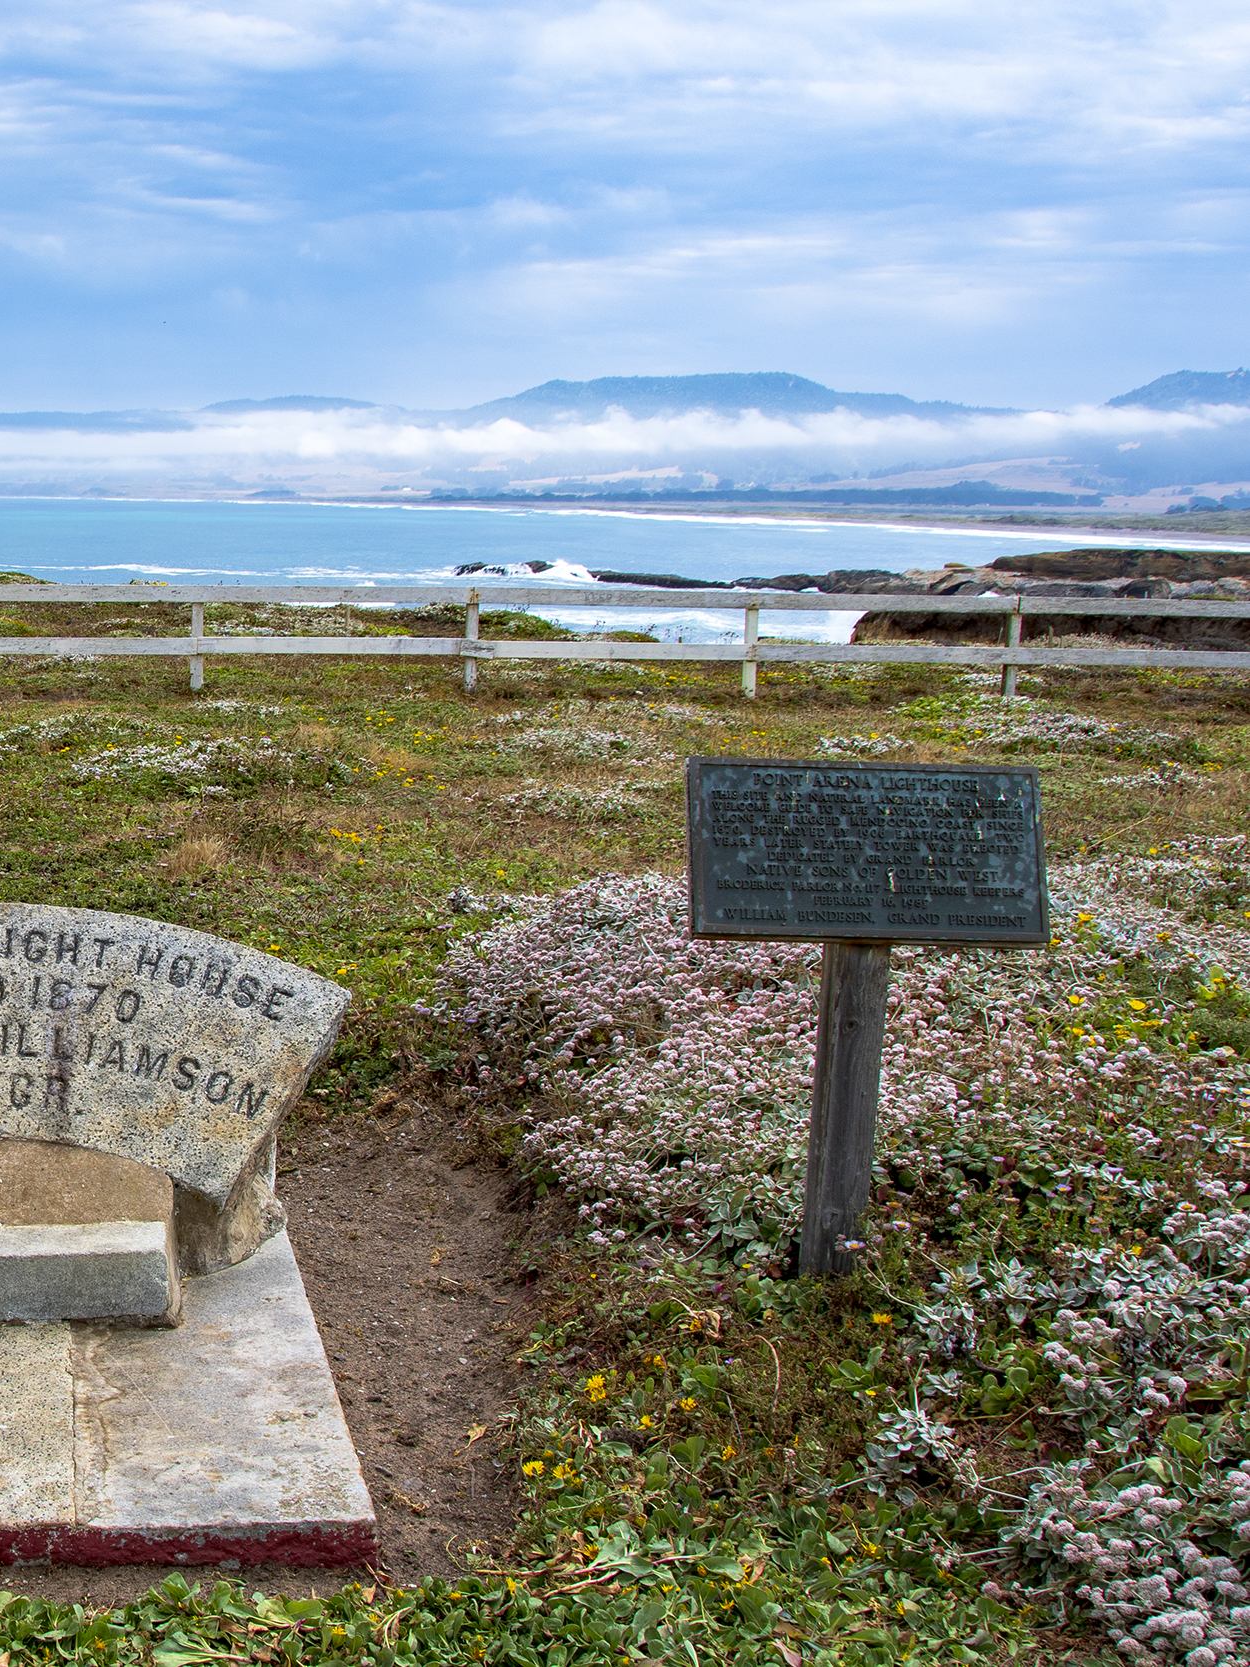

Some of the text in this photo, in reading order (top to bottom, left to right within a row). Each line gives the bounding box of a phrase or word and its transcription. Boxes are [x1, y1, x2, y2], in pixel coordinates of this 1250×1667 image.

[753, 773, 979, 792] POINT ARENA LIGHTHOUSE
[712, 790, 738, 800] THIS
[744, 791, 768, 800] SITE
[774, 791, 802, 801] AND
[809, 793, 865, 803] NATURAL
[871, 795, 939, 806] LANDMARK
[947, 797, 971, 807] HAS
[976, 798, 1008, 808] BEEN
[712, 801, 1023, 819] WELCOME GUIDE TO SAFE NAVIGATION FOR SHIPS
[713, 814, 755, 824] ALONG
[763, 814, 786, 824] THE
[793, 815, 840, 825] RUGGED
[851, 816, 929, 829] MENDOCINO
[987, 821, 1025, 831] SINCE
[751, 825, 826, 837] DESTROYED
[834, 828, 848, 837] BY
[858, 828, 885, 839] 1906
[996, 833, 1024, 843] TWO
[713, 837, 755, 847] YEARS
[764, 838, 805, 848] LATER
[814, 839, 865, 850] STATELY
[874, 842, 920, 852] TOWER
[928, 843, 955, 853] WAS
[768, 851, 976, 866] DEDICATED BY GRAND PARLOR
[747, 863, 997, 882] NATIVE SONS OF GOLDEN WEST
[717, 879, 785, 890] BRODERICK
[792, 881, 840, 892] PARLOR
[864, 884, 880, 894] 117
[973, 886, 1025, 897] KEEPERS
[813, 895, 874, 906] FEBRUARY
[723, 908, 787, 921] WILLIAM
[888, 913, 940, 924] GRAND
[948, 914, 1026, 927] PRESIDENT
[137, 944, 294, 1022] HOUSE
[31, 976, 140, 1023] 1870
